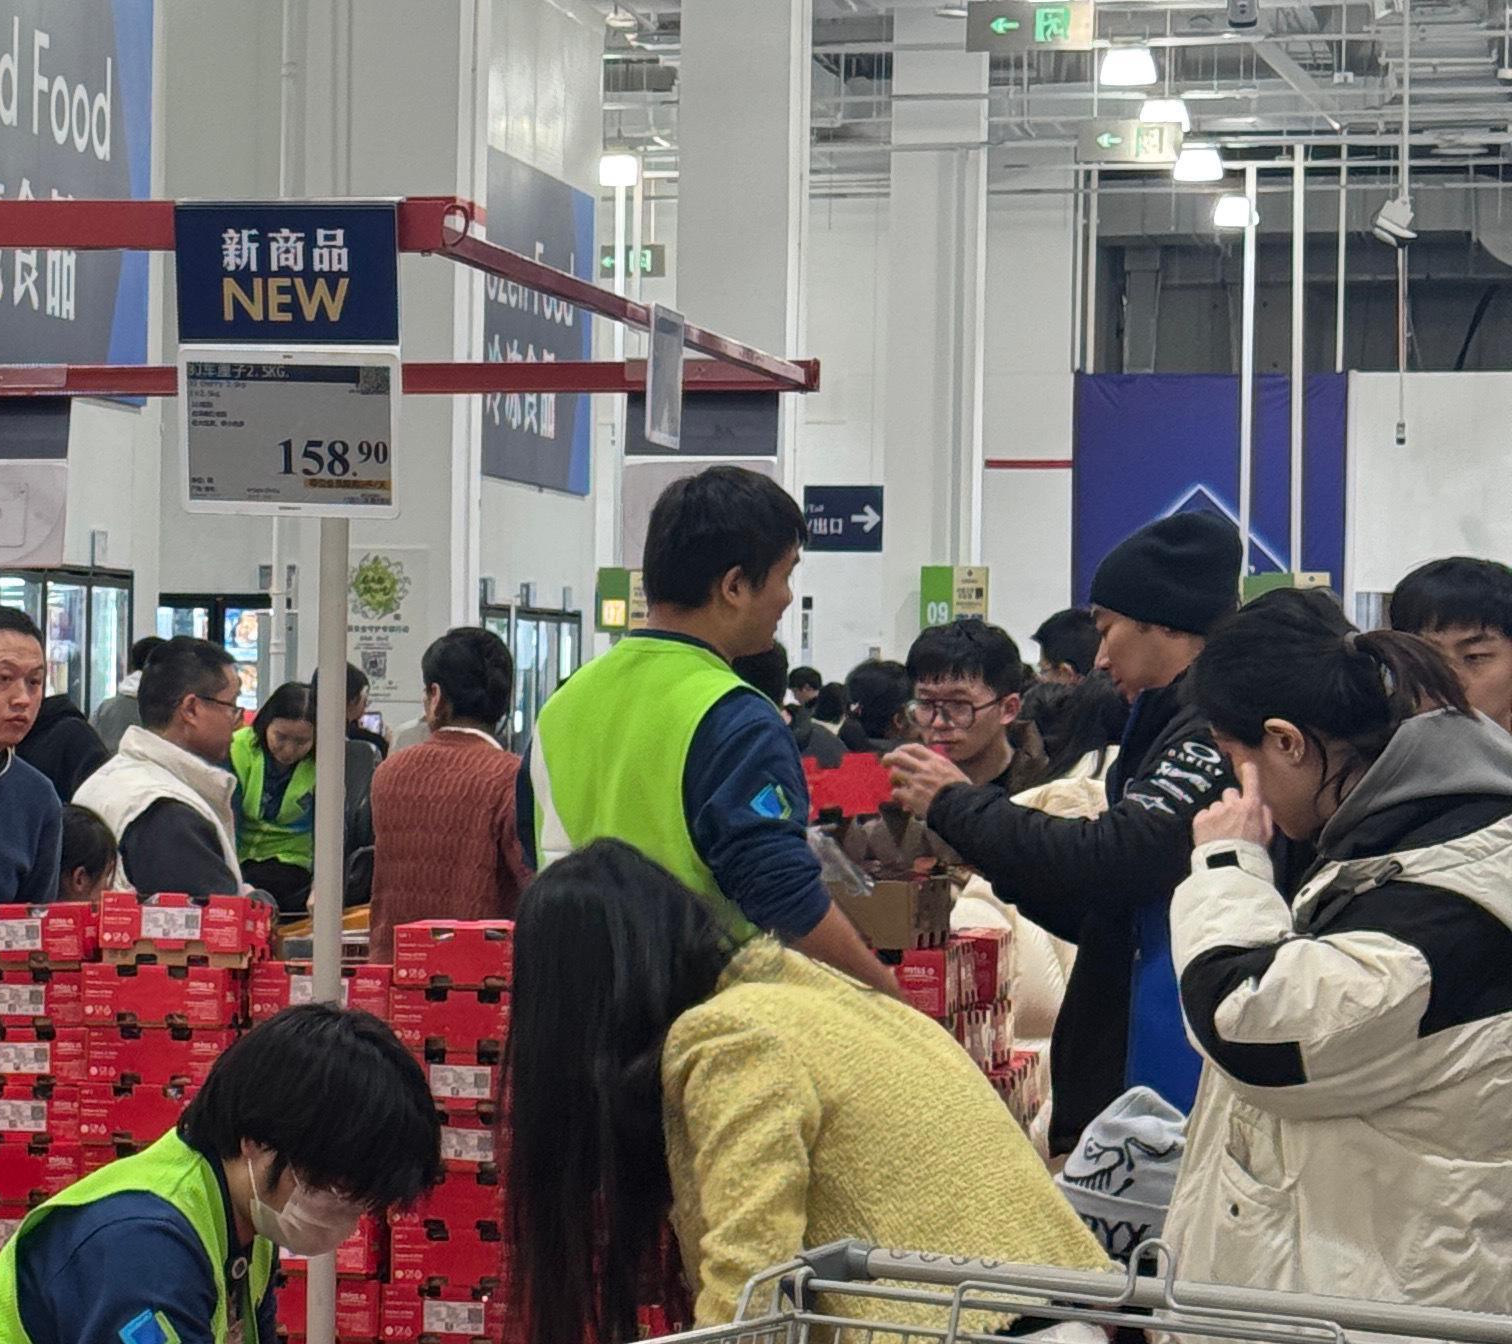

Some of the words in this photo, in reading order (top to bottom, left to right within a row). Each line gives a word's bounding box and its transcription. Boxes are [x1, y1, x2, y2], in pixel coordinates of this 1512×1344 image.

[32, 29, 112, 162] Food
[222, 228, 348, 272] 新商品
[223, 277, 349, 322] NEW
[277, 438, 389, 477] 158.90
[926, 601, 949, 624] 09
